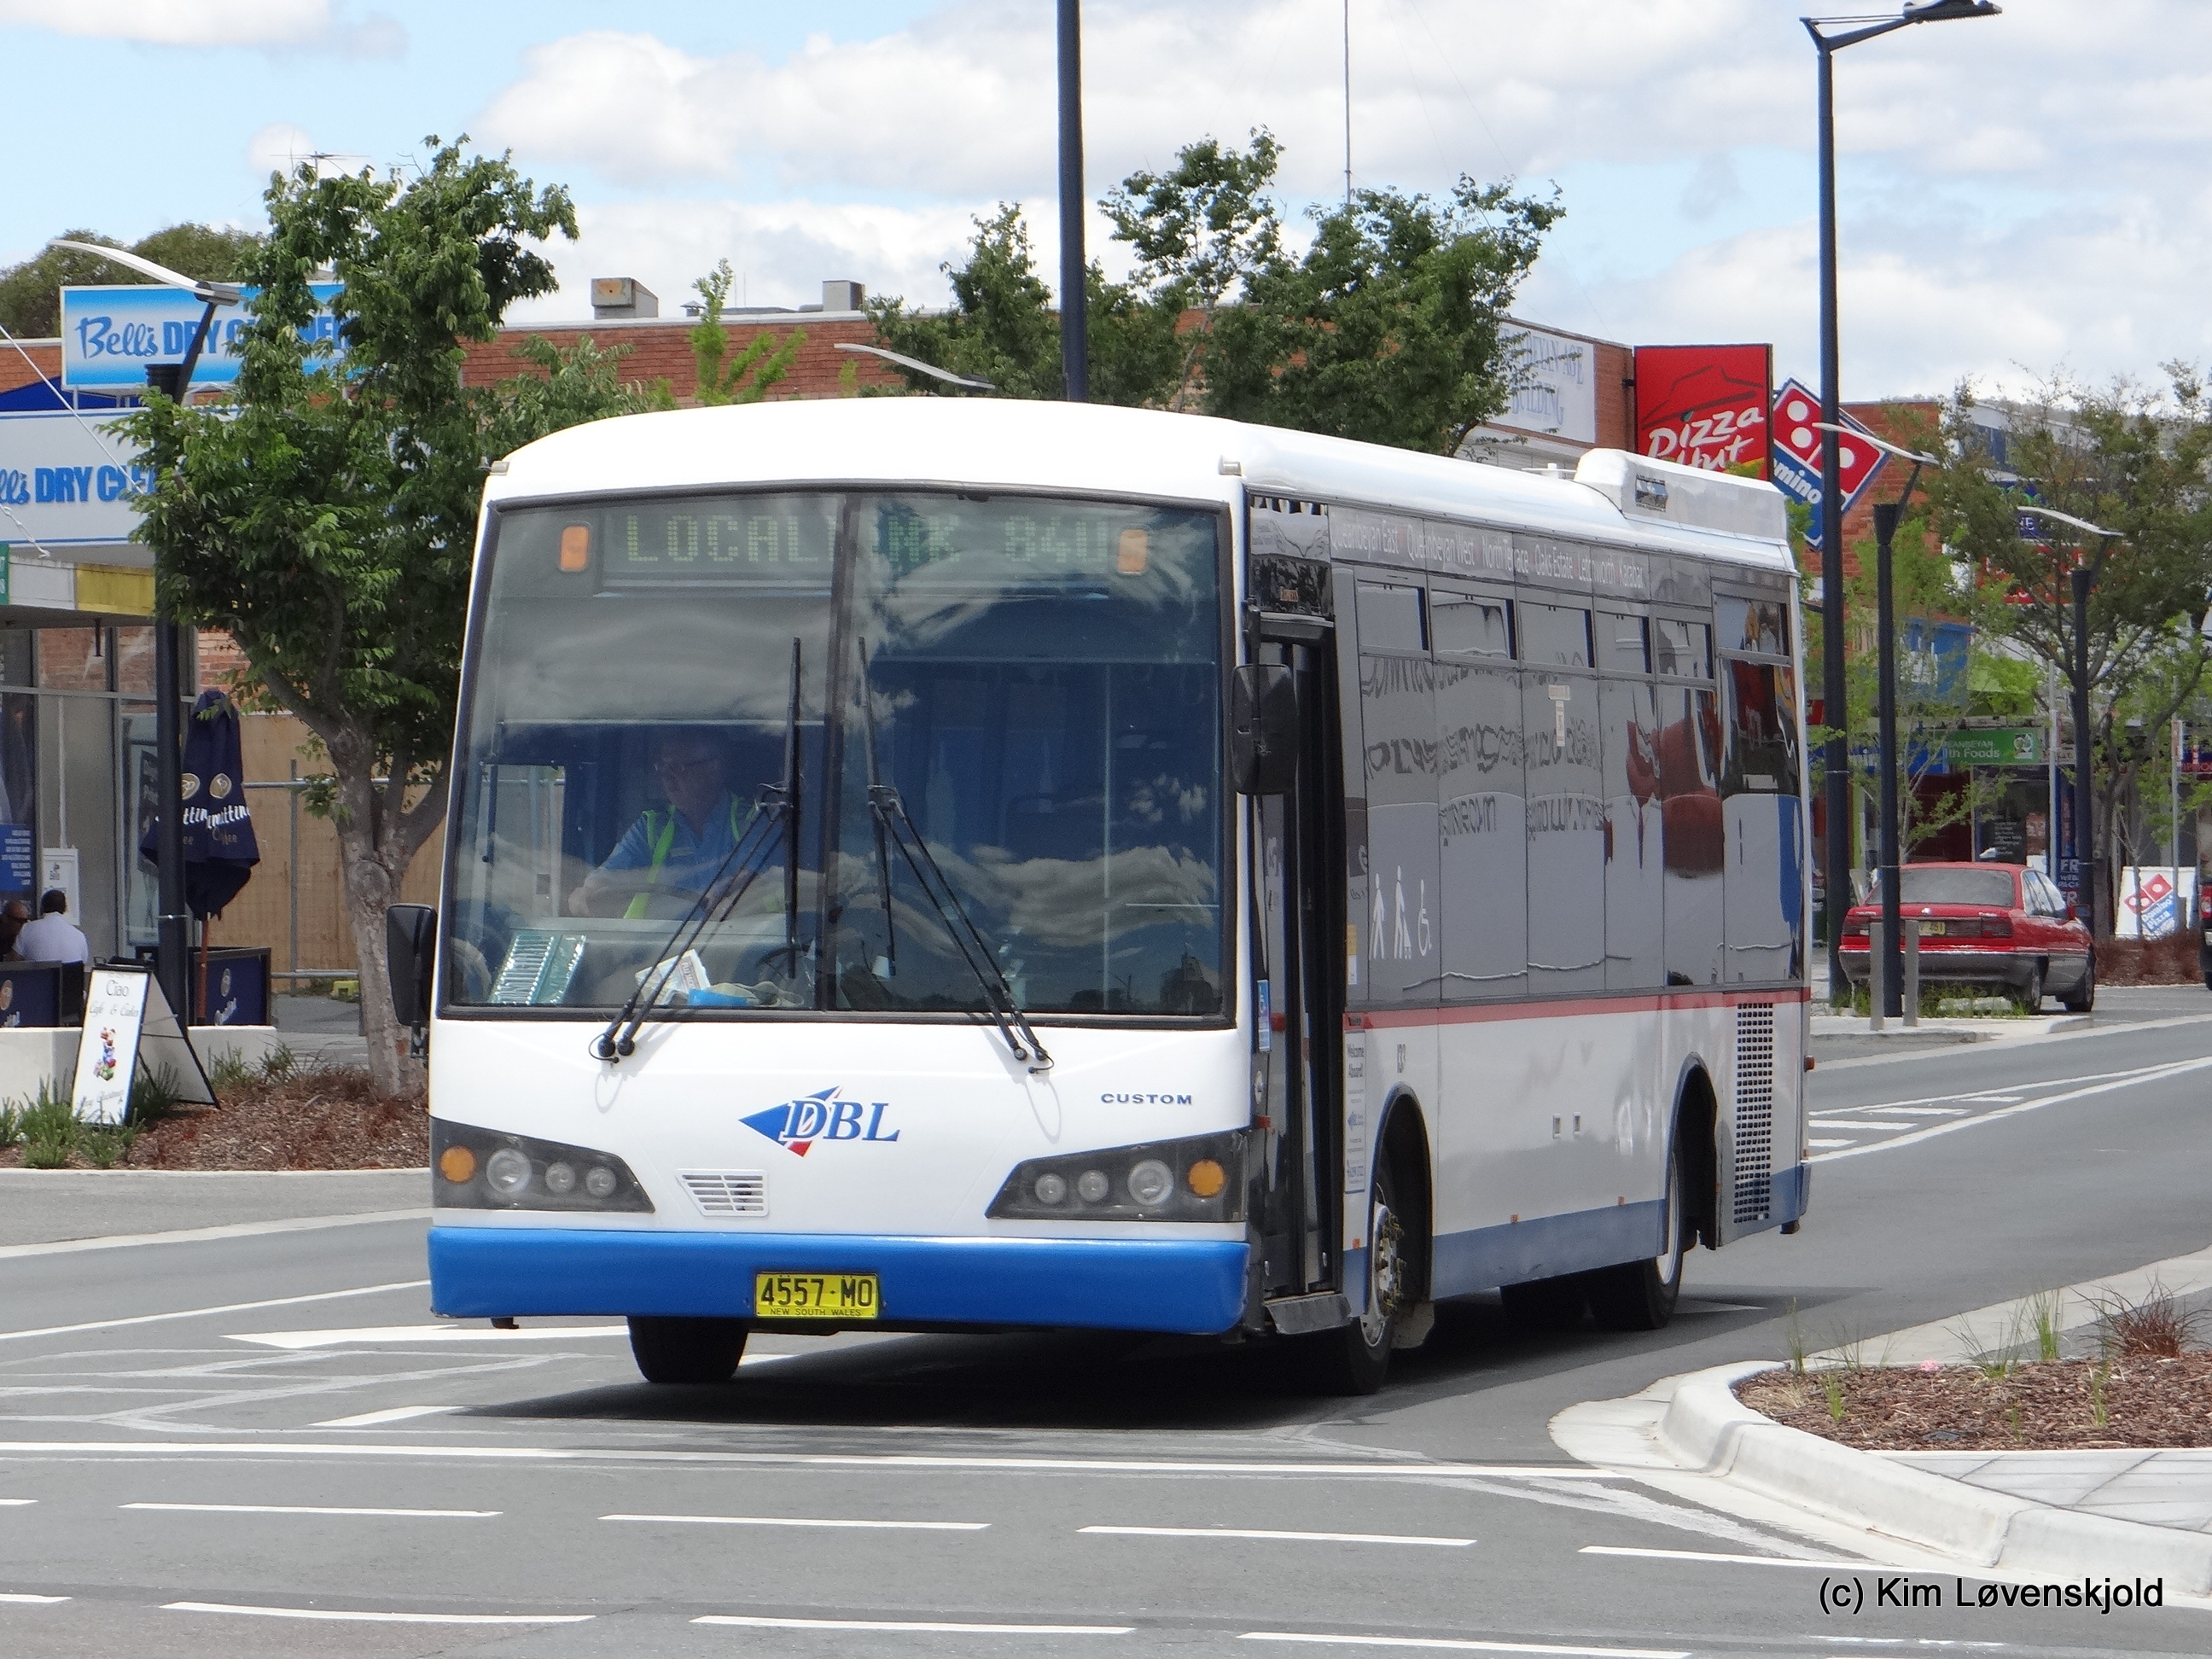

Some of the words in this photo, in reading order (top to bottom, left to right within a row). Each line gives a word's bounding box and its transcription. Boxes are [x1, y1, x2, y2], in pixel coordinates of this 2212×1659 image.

[75, 316, 157, 359] Bell's
[1648, 407, 1765, 458] Pizza
[0, 469, 31, 504] ll's
[35, 466, 94, 503] DRY
[1774, 457, 1822, 504] mino
[626, 515, 818, 562] LOCAL
[1964, 748, 2000, 759] Foods
[106, 979, 130, 997] Ciao
[1100, 1093, 1193, 1105] CUSTOM
[783, 1101, 899, 1142] DBL
